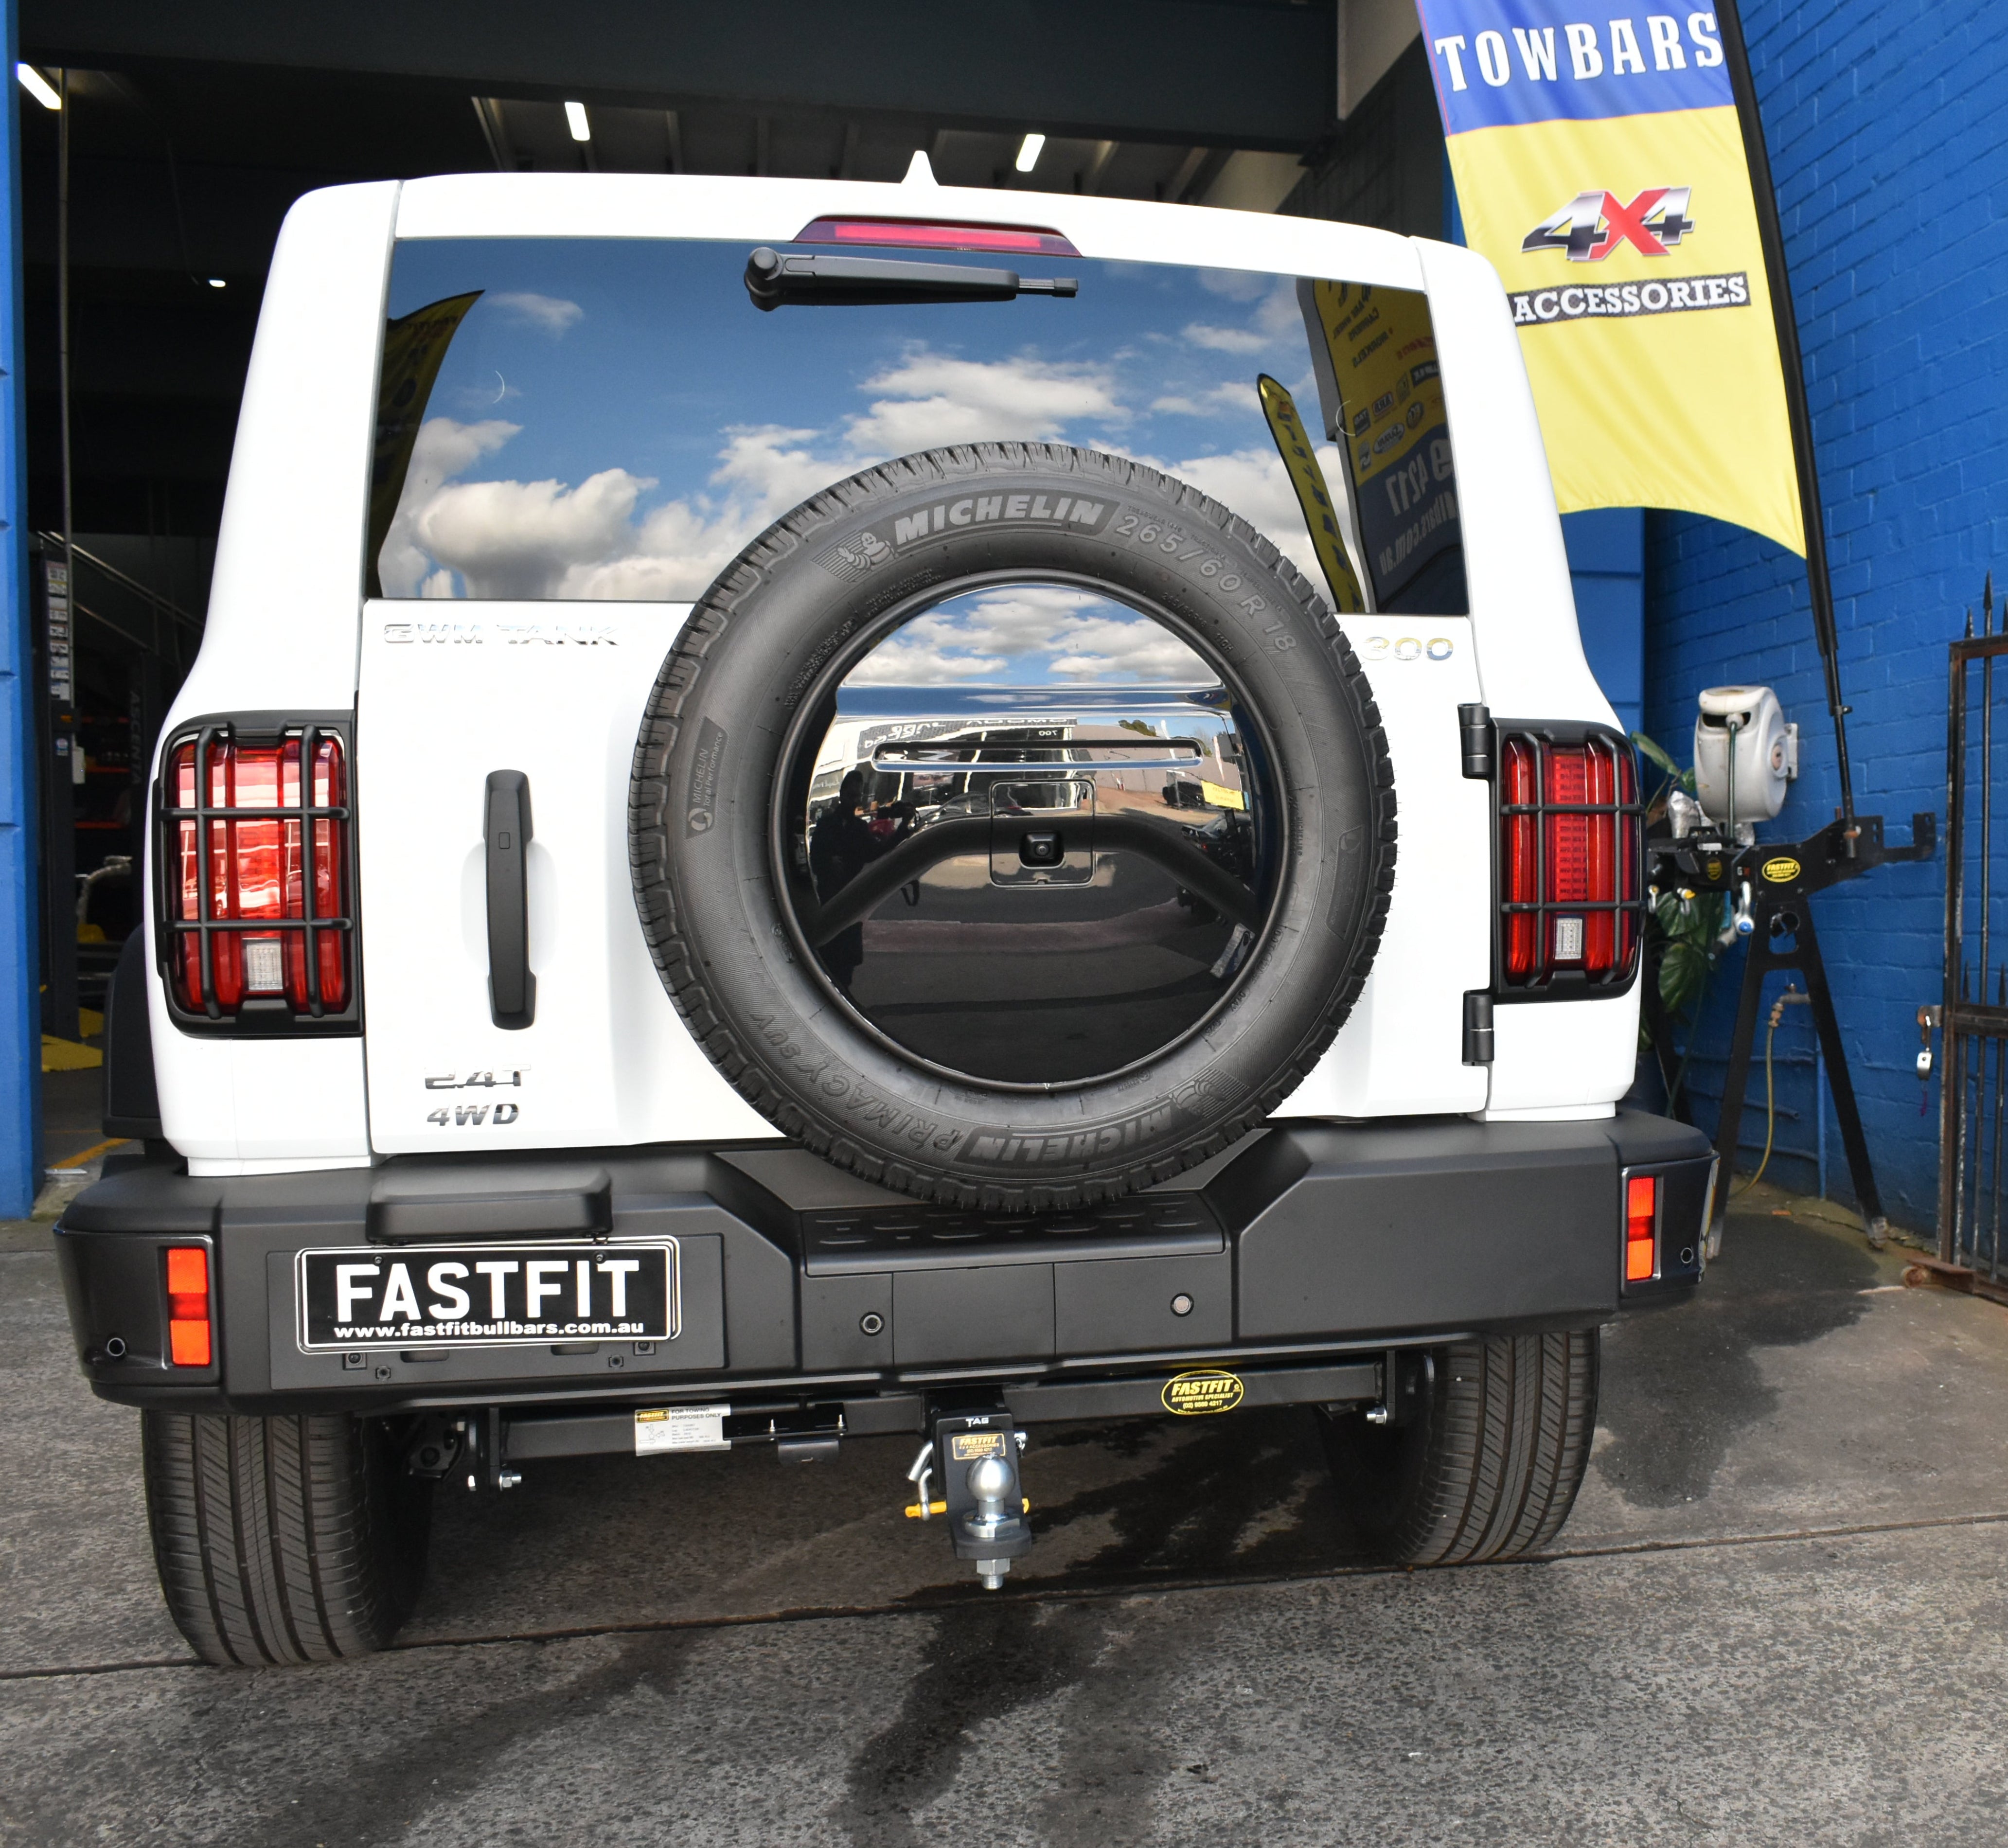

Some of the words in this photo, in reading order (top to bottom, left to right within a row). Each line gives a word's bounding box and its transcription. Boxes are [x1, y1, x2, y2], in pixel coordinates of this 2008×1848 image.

[1435, 12, 1724, 92] TOWBARS
[1513, 276, 1747, 322] ACCESSORIES
[894, 493, 1106, 544] MICHELIN
[1115, 514, 1243, 593] 265/60
[1240, 594, 1267, 616] R
[1263, 620, 1297, 652] 18
[384, 623, 484, 644] GWM
[496, 623, 620, 646] TANK
[1361, 636, 1454, 661] 300
[692, 747, 709, 804] MICHELIN
[749, 1013, 801, 1058] SUV
[424, 1064, 532, 1089] 2.4T
[426, 1102, 520, 1127] 4WD
[798, 1059, 961, 1152] PRIMACY
[967, 1105, 1173, 1163] MICHELIN
[336, 1260, 640, 1322] FASTFIT
[334, 1320, 644, 1339] www.fastfitbullbars.com.au
[1171, 1379, 1234, 1396] FASTFIT
[1171, 1394, 1204, 1403] AUTOMOTIVE
[965, 1417, 989, 1428] TAG
[959, 1436, 997, 1446] FASTFIT
